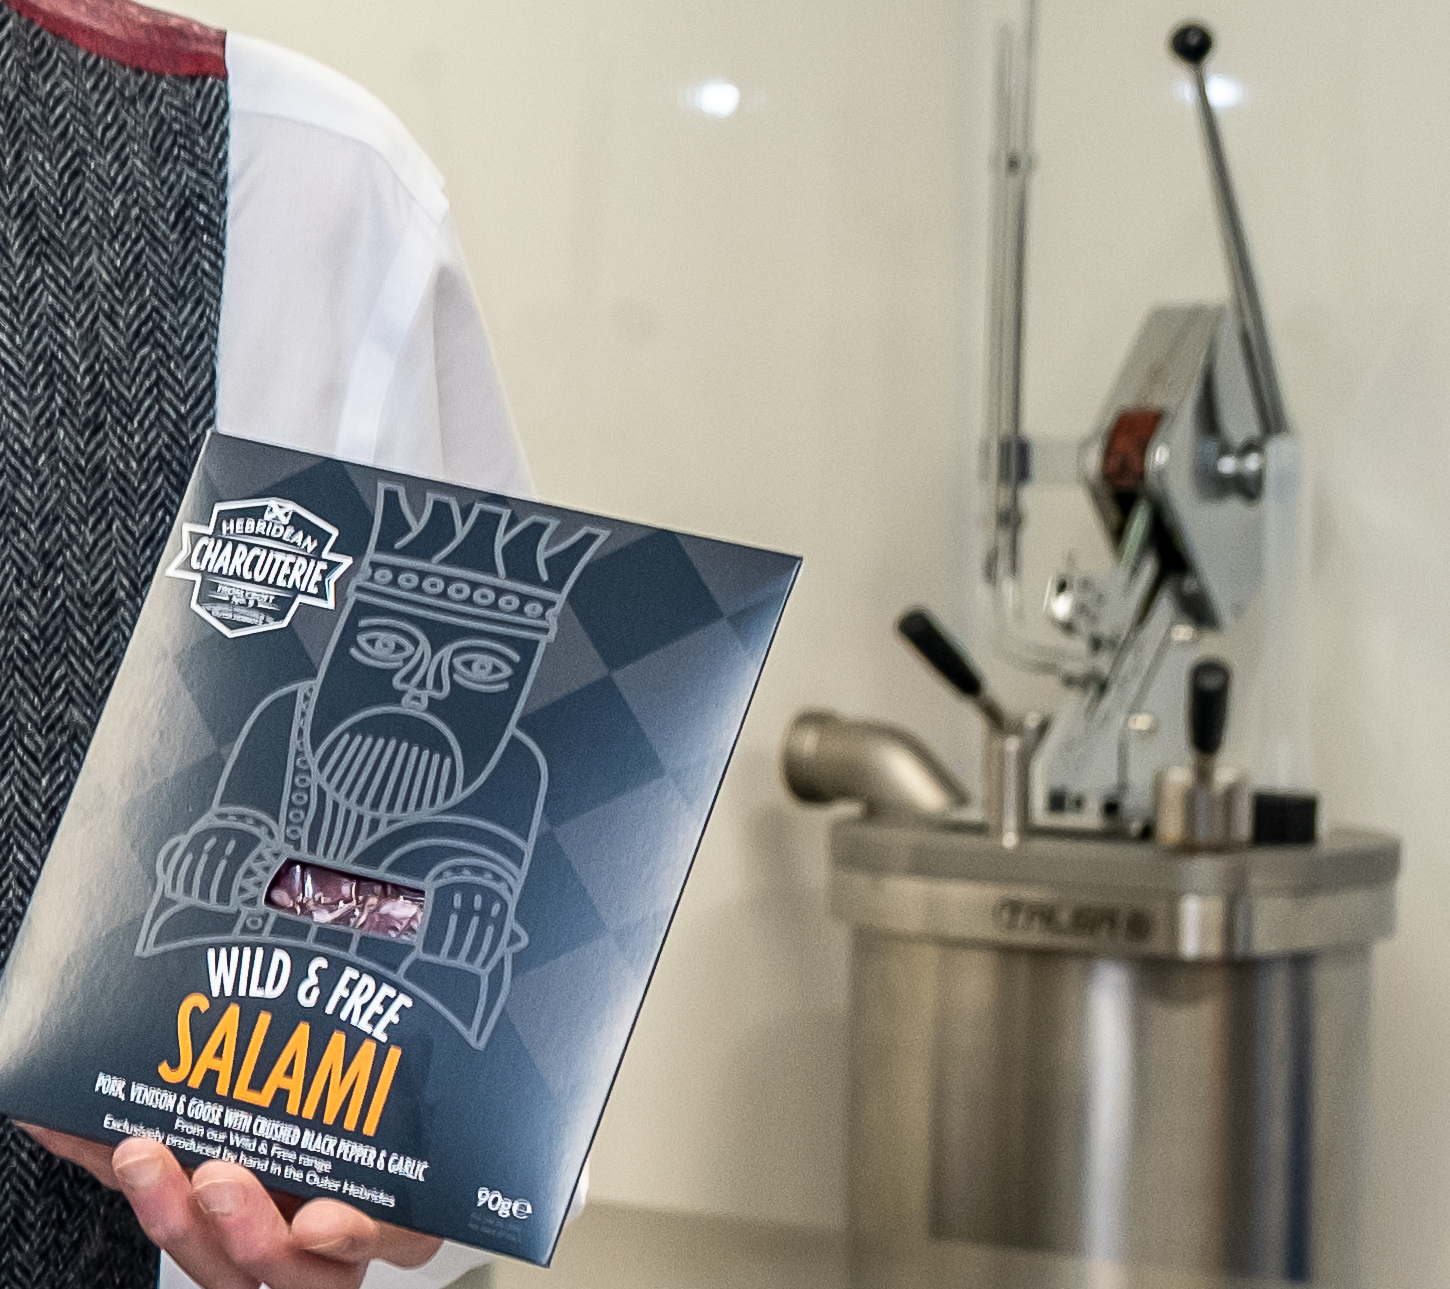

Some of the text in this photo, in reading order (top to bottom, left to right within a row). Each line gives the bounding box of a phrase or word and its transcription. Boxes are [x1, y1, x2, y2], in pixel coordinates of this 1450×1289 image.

[190, 535, 328, 594] CHARCUTERIE
[221, 516, 318, 554] HEBRIDEAN
[206, 945, 414, 1044] WILD & FREE
[157, 992, 403, 1138] SALAMI
[94, 1071, 127, 1101] PORK,
[129, 1081, 178, 1113] VENISON
[187, 1096, 225, 1126] GOOSE
[223, 1105, 253, 1134] WITH
[252, 1115, 301, 1146] CRUSHED
[300, 1127, 338, 1158] BLACK
[336, 1137, 377, 1169] PEPPER
[387, 1152, 430, 1182] GARLIC
[174, 1115, 205, 1138] From
[228, 1130, 258, 1153] Wild
[270, 1142, 297, 1163] Free
[298, 1151, 333, 1174] range
[238, 1151, 269, 1172] hand
[269, 1160, 282, 1177] in
[283, 1164, 304, 1183] the
[305, 1169, 342, 1193] Outer
[341, 1178, 396, 1209] Hebrides
